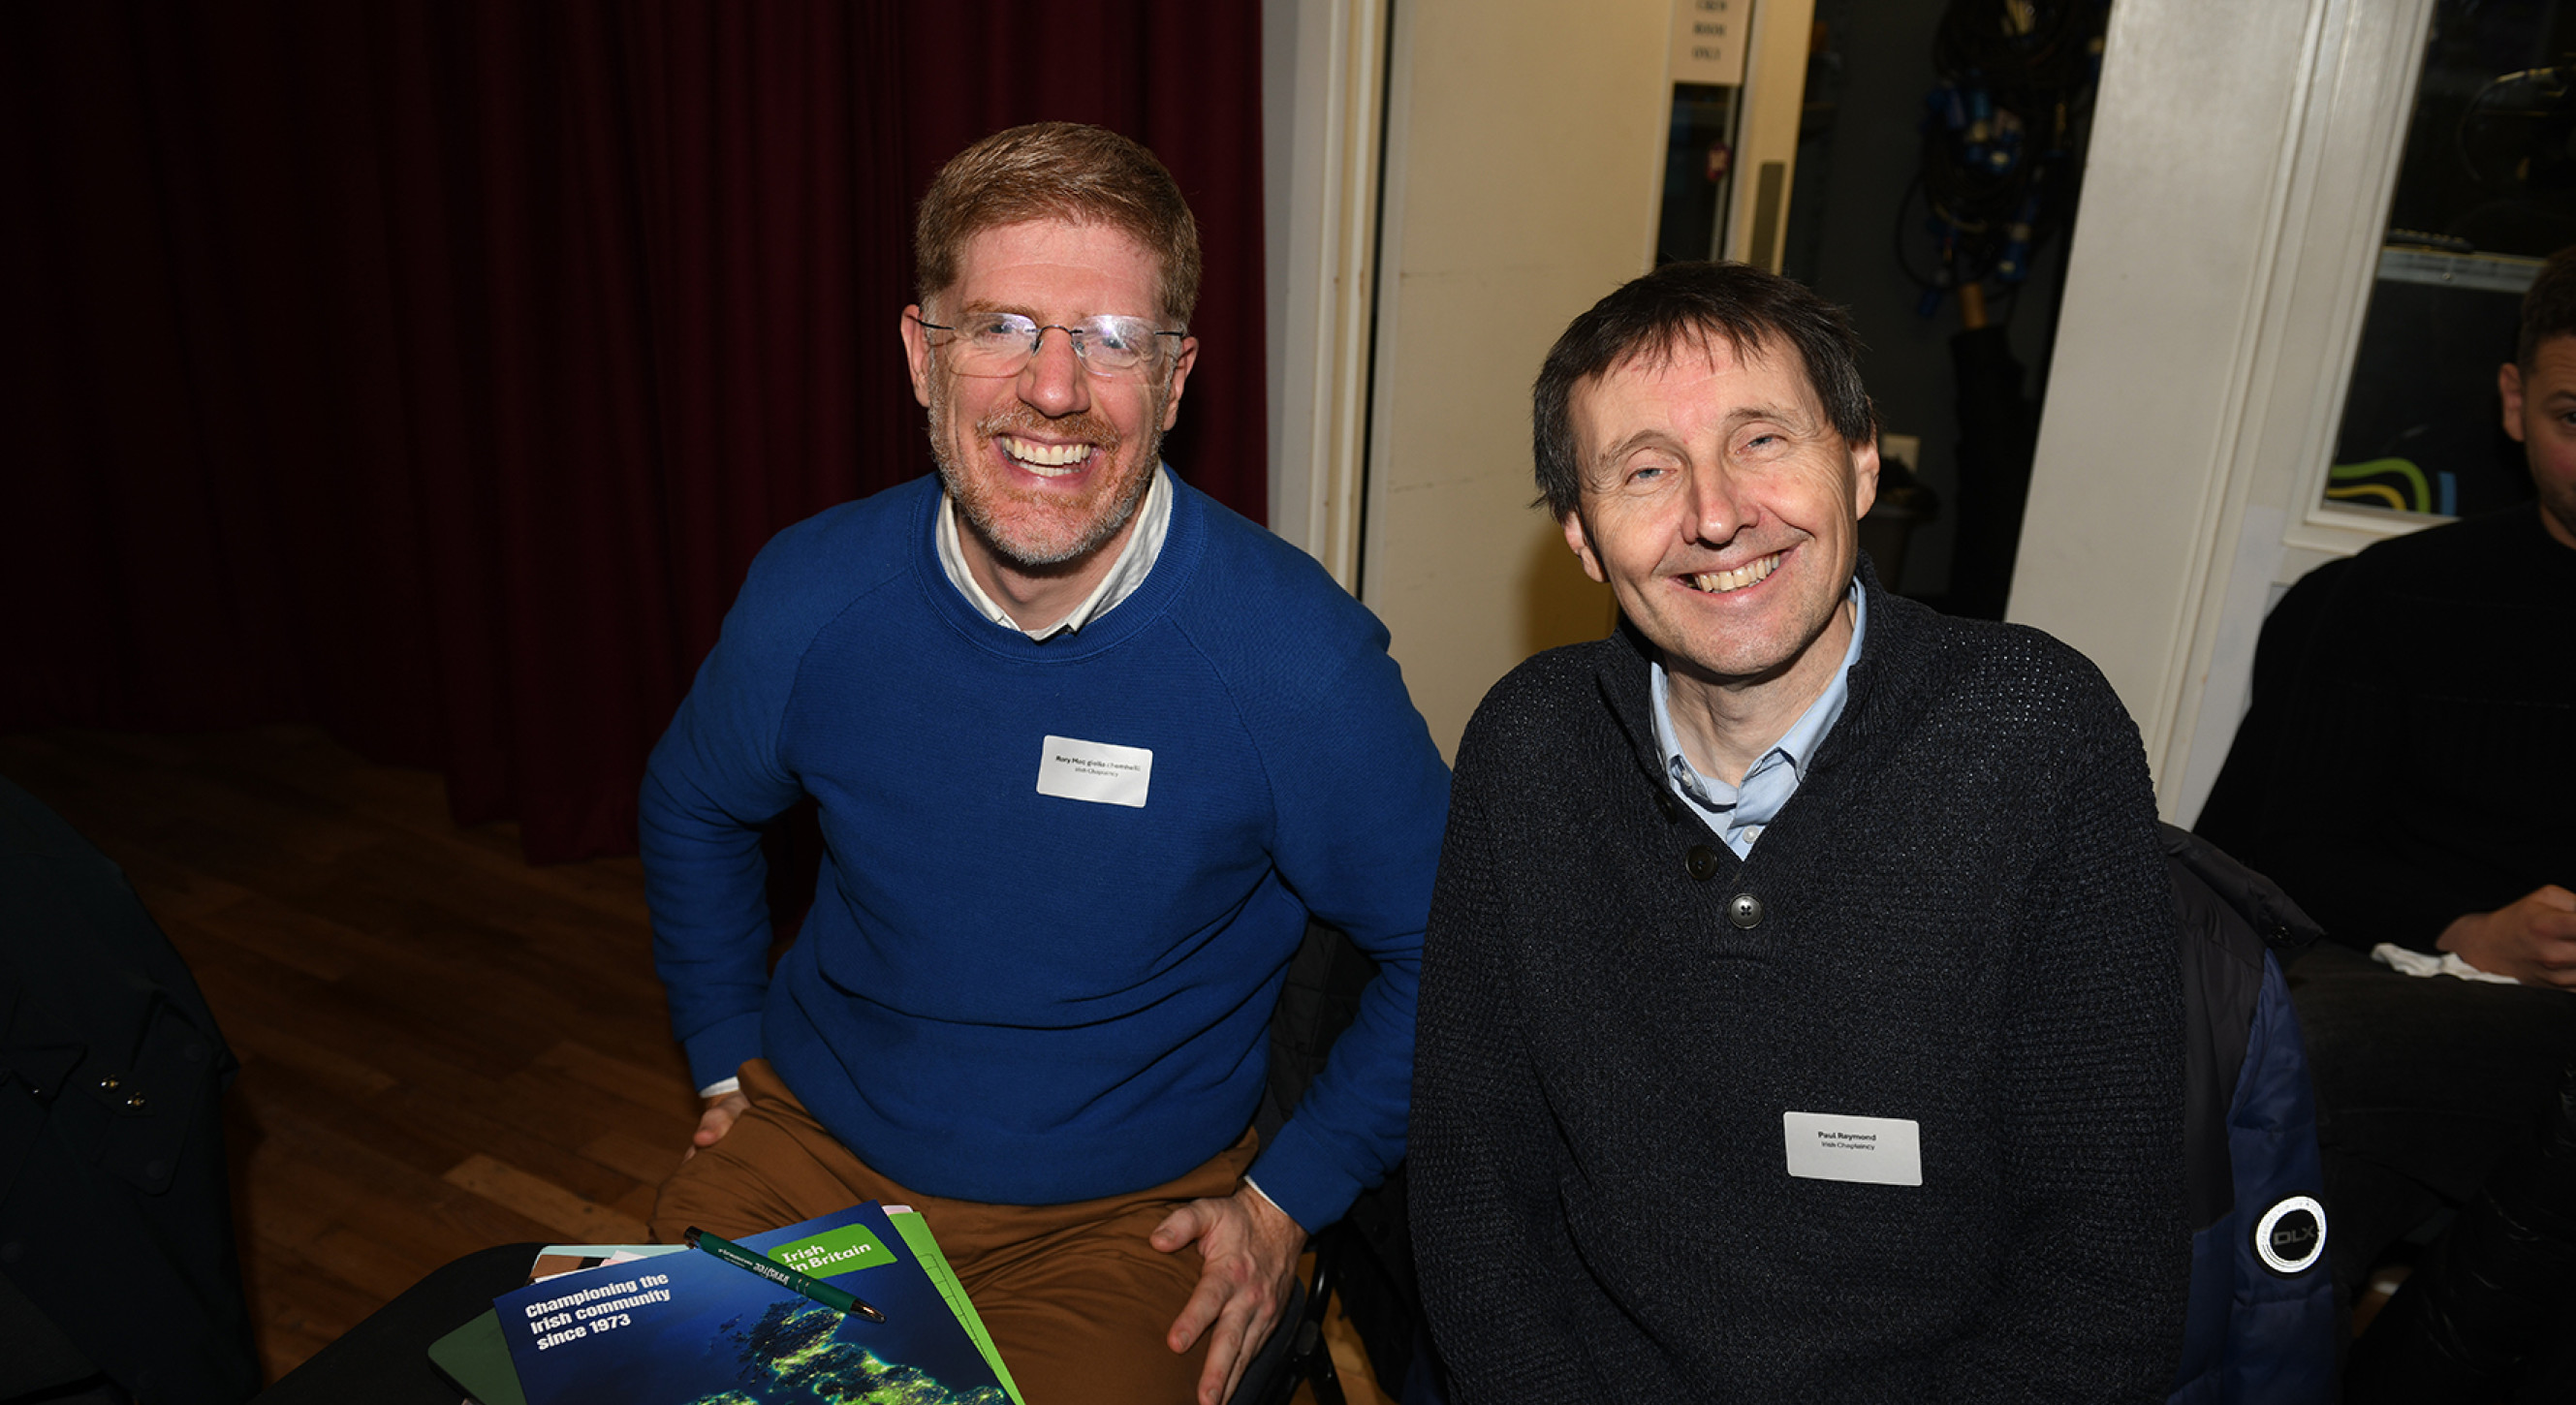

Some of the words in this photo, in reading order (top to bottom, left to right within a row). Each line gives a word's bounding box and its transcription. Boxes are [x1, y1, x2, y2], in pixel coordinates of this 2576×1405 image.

[1817, 1131, 1836, 1140] Paul
[1838, 1132, 1876, 1141] Raymond
[2274, 1226, 2316, 1245] DLX
[782, 1245, 825, 1263] Irish
[808, 1243, 871, 1268] Britain
[525, 1279, 638, 1319] Championing
[640, 1273, 669, 1289] the
[530, 1311, 573, 1334] Irish
[575, 1289, 672, 1321] community
[536, 1326, 587, 1351] since
[588, 1313, 631, 1334] 1973
